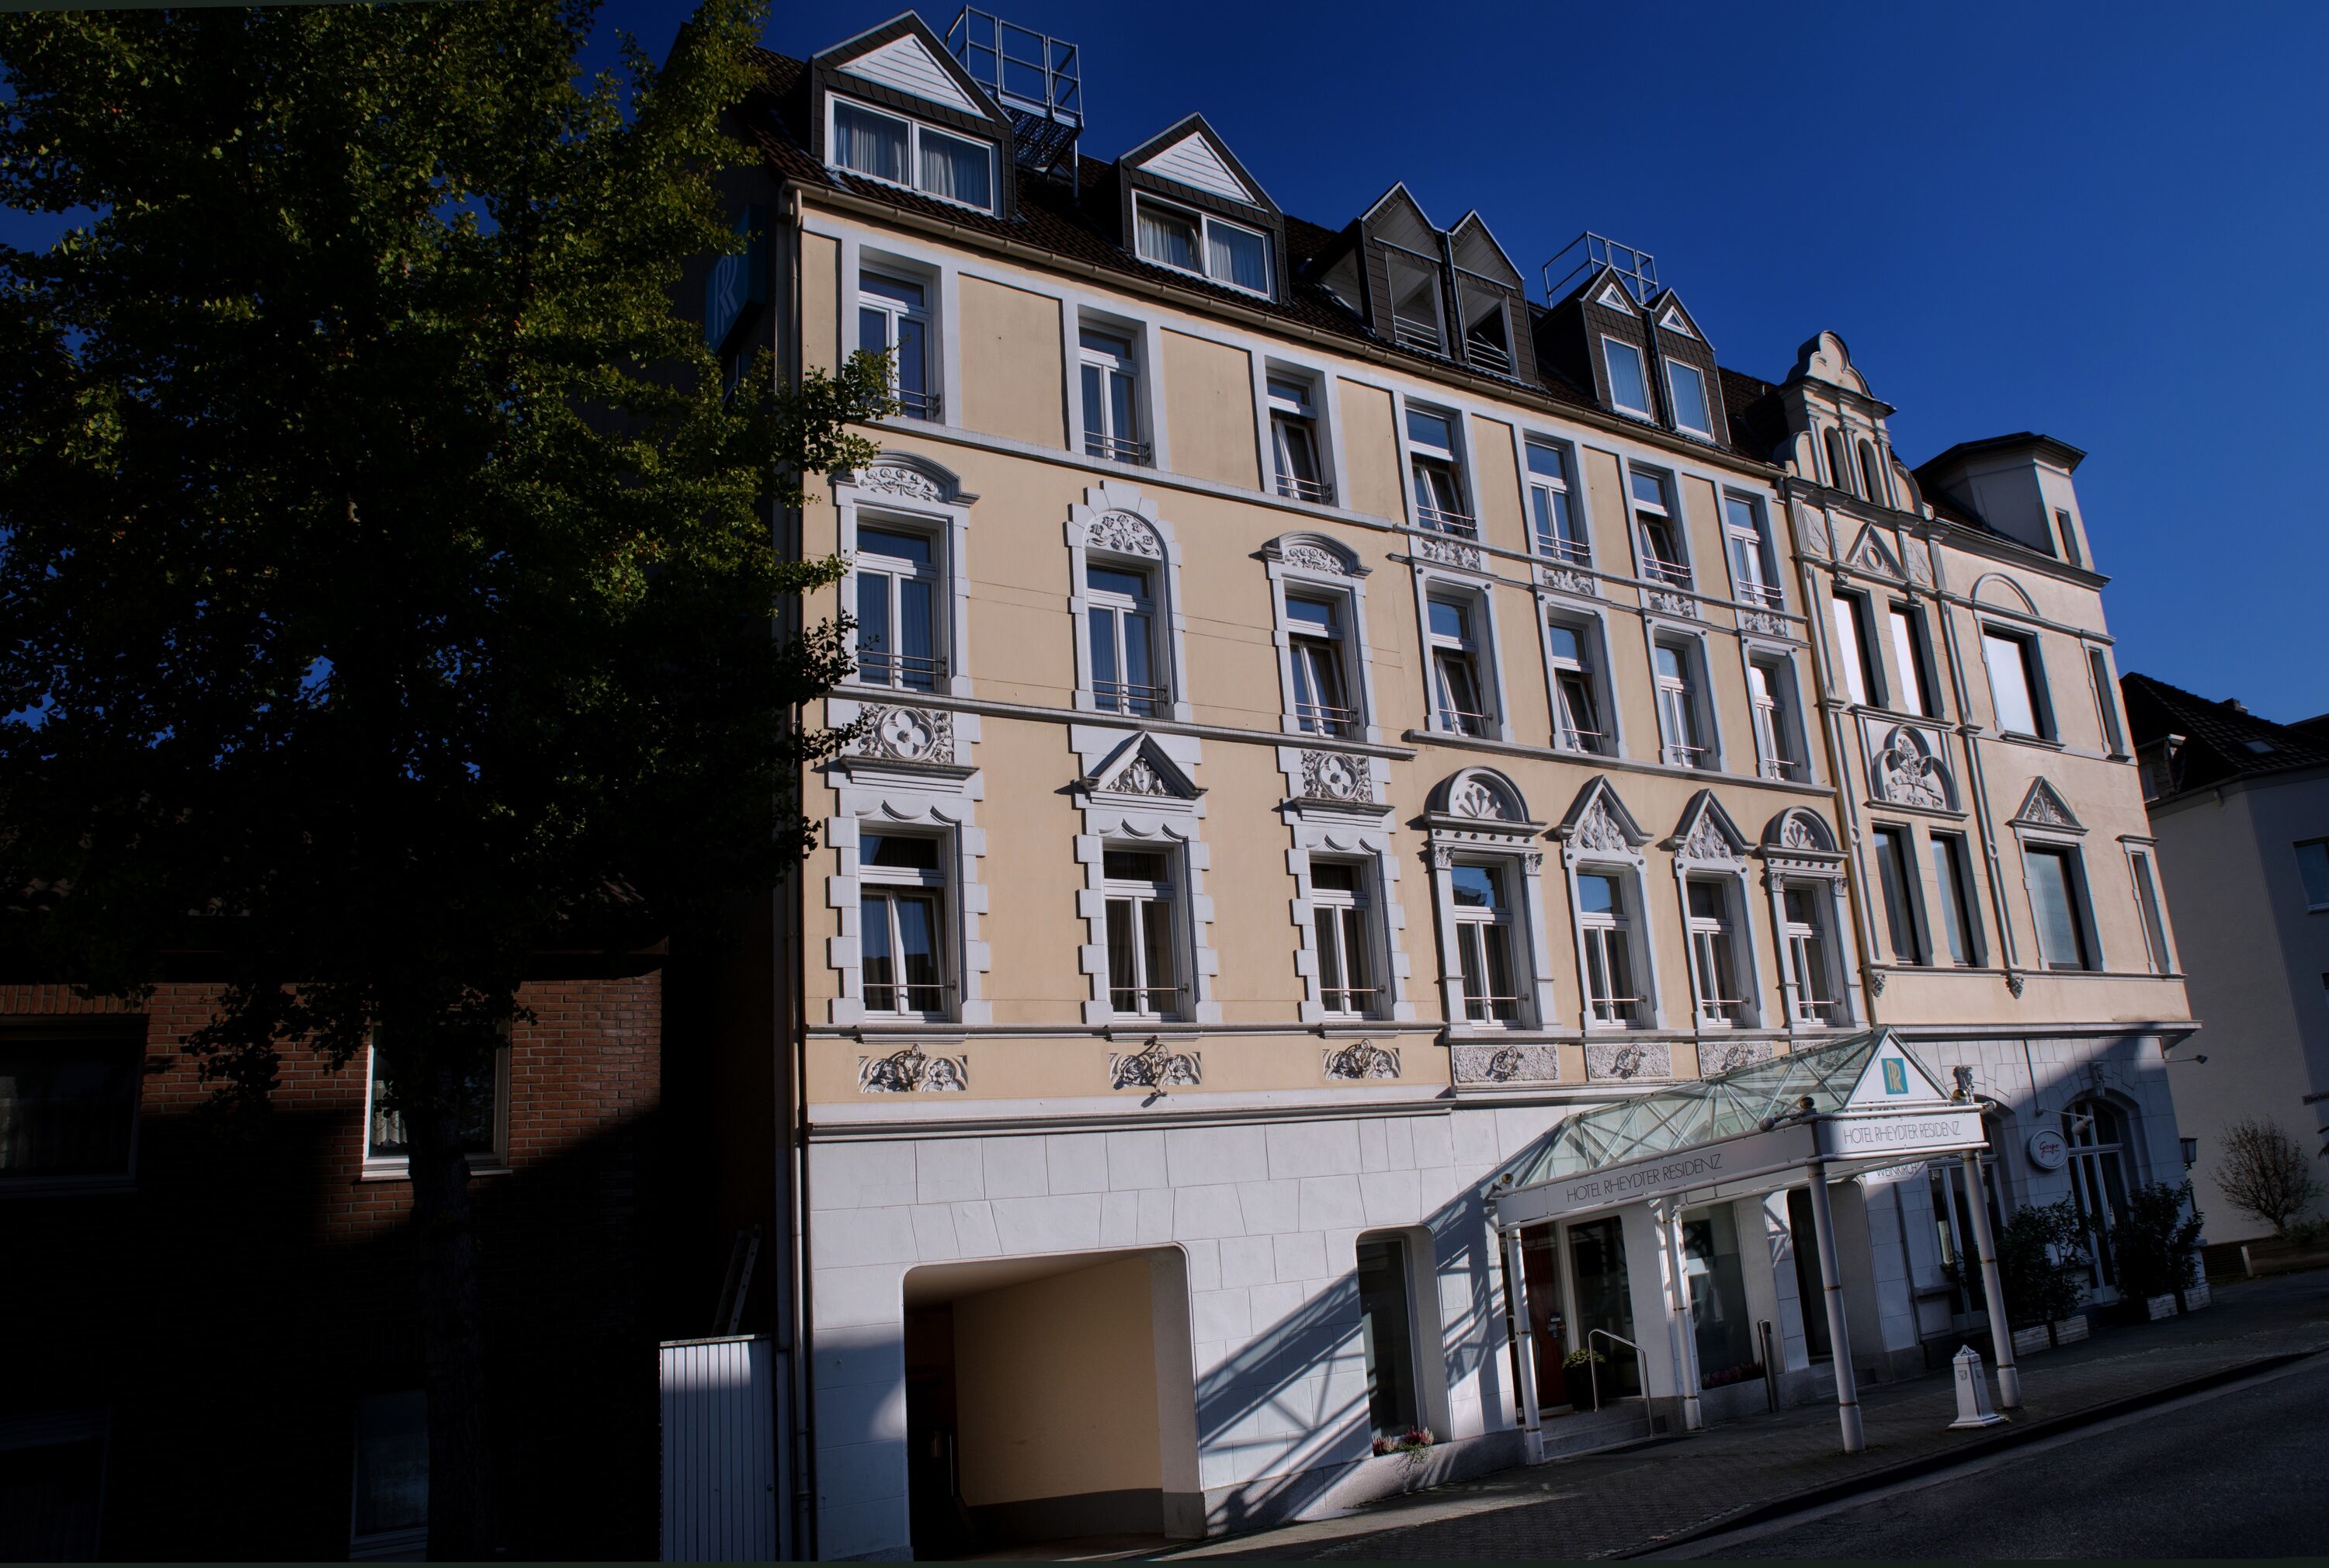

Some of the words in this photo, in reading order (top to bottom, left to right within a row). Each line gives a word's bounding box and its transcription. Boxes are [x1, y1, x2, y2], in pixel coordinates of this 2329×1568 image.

[1844, 1127, 1873, 1144] HOTEL
[1875, 1124, 1918, 1142] RHEYDTER
[1920, 1121, 1961, 1139] RESIDENZ
[1567, 1182, 1601, 1203] HOTEL
[1604, 1169, 1660, 1195] RHEYDTER
[1663, 1153, 1723, 1181] RESIDENZ
